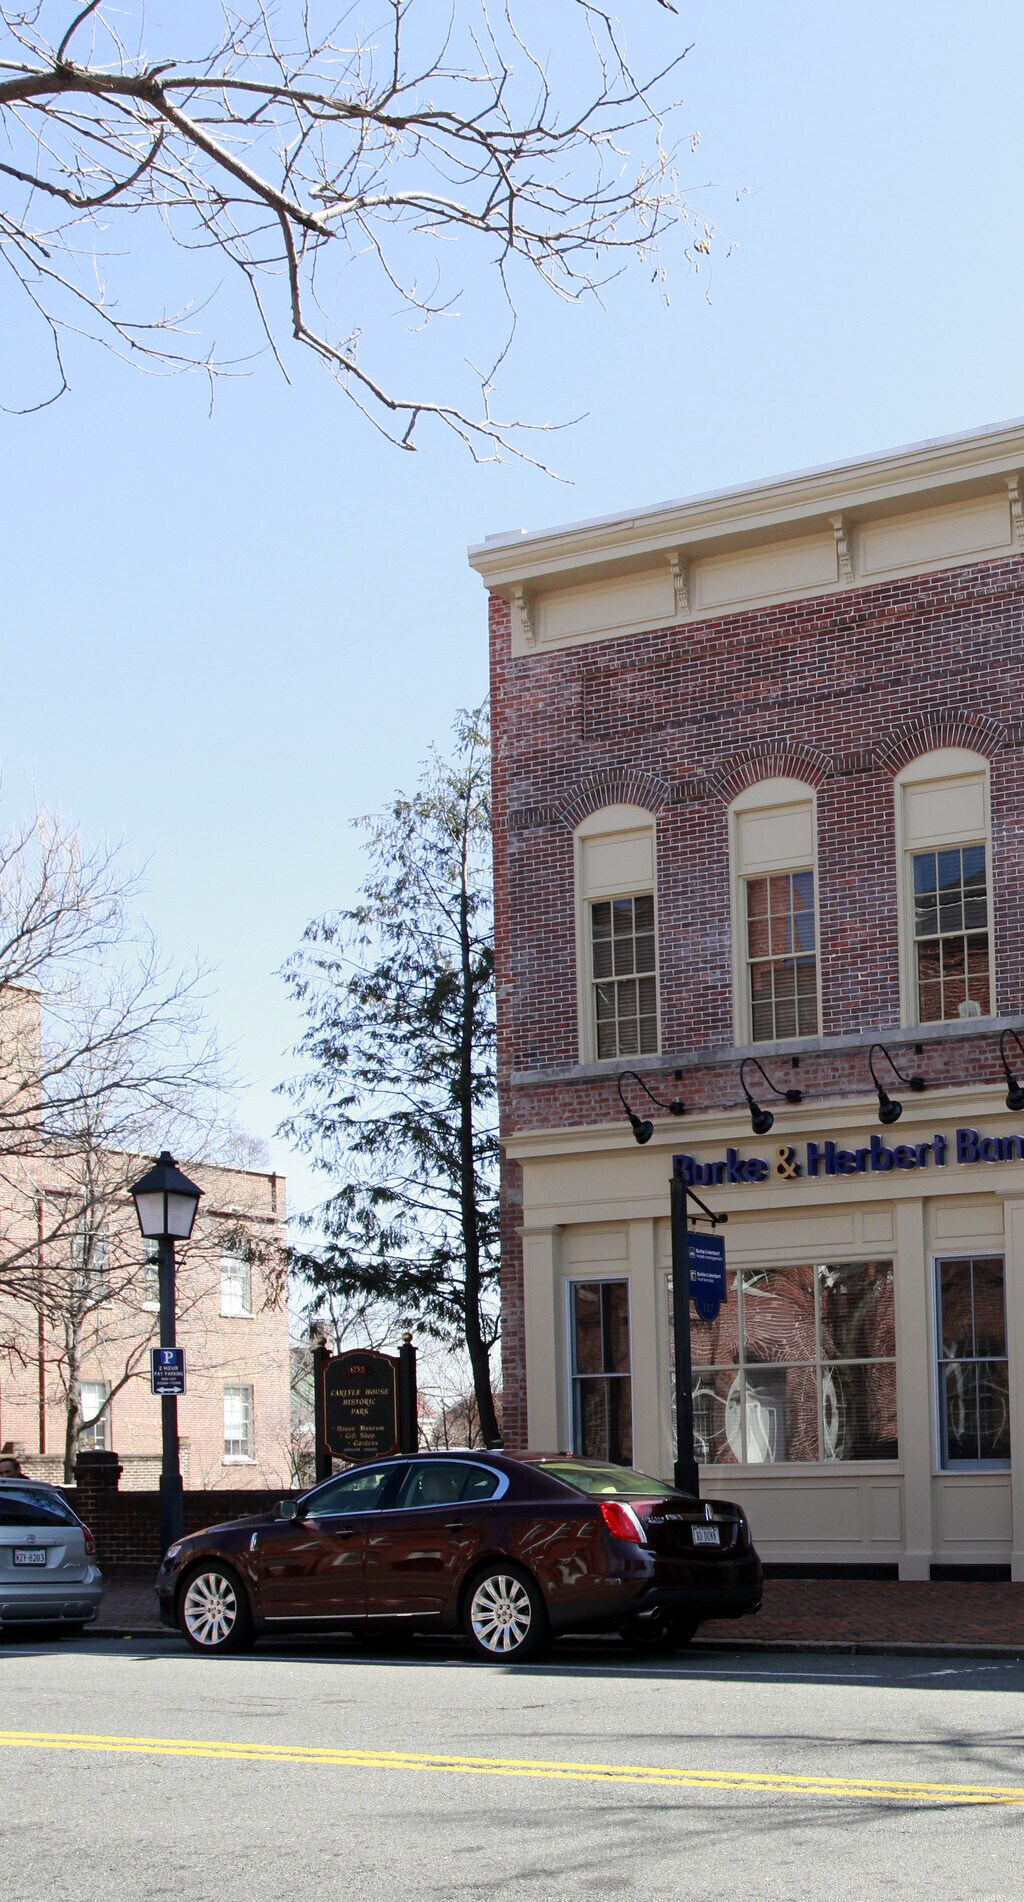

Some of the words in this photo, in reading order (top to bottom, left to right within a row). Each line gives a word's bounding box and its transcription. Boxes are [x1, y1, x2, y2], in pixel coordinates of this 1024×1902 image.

[672, 1148, 769, 1187] Burke
[775, 1144, 798, 1180] &
[807, 1134, 947, 1178] Herbert
[163, 1351, 173, 1364] P
[350, 1365, 365, 1374] 1752
[330, 1389, 361, 1398] CARLYLE
[365, 1388, 389, 1396] HOUSE
[342, 1398, 376, 1407] HISTORIC
[351, 1408, 369, 1416] PARK
[360, 1432, 376, 1440] Shop
